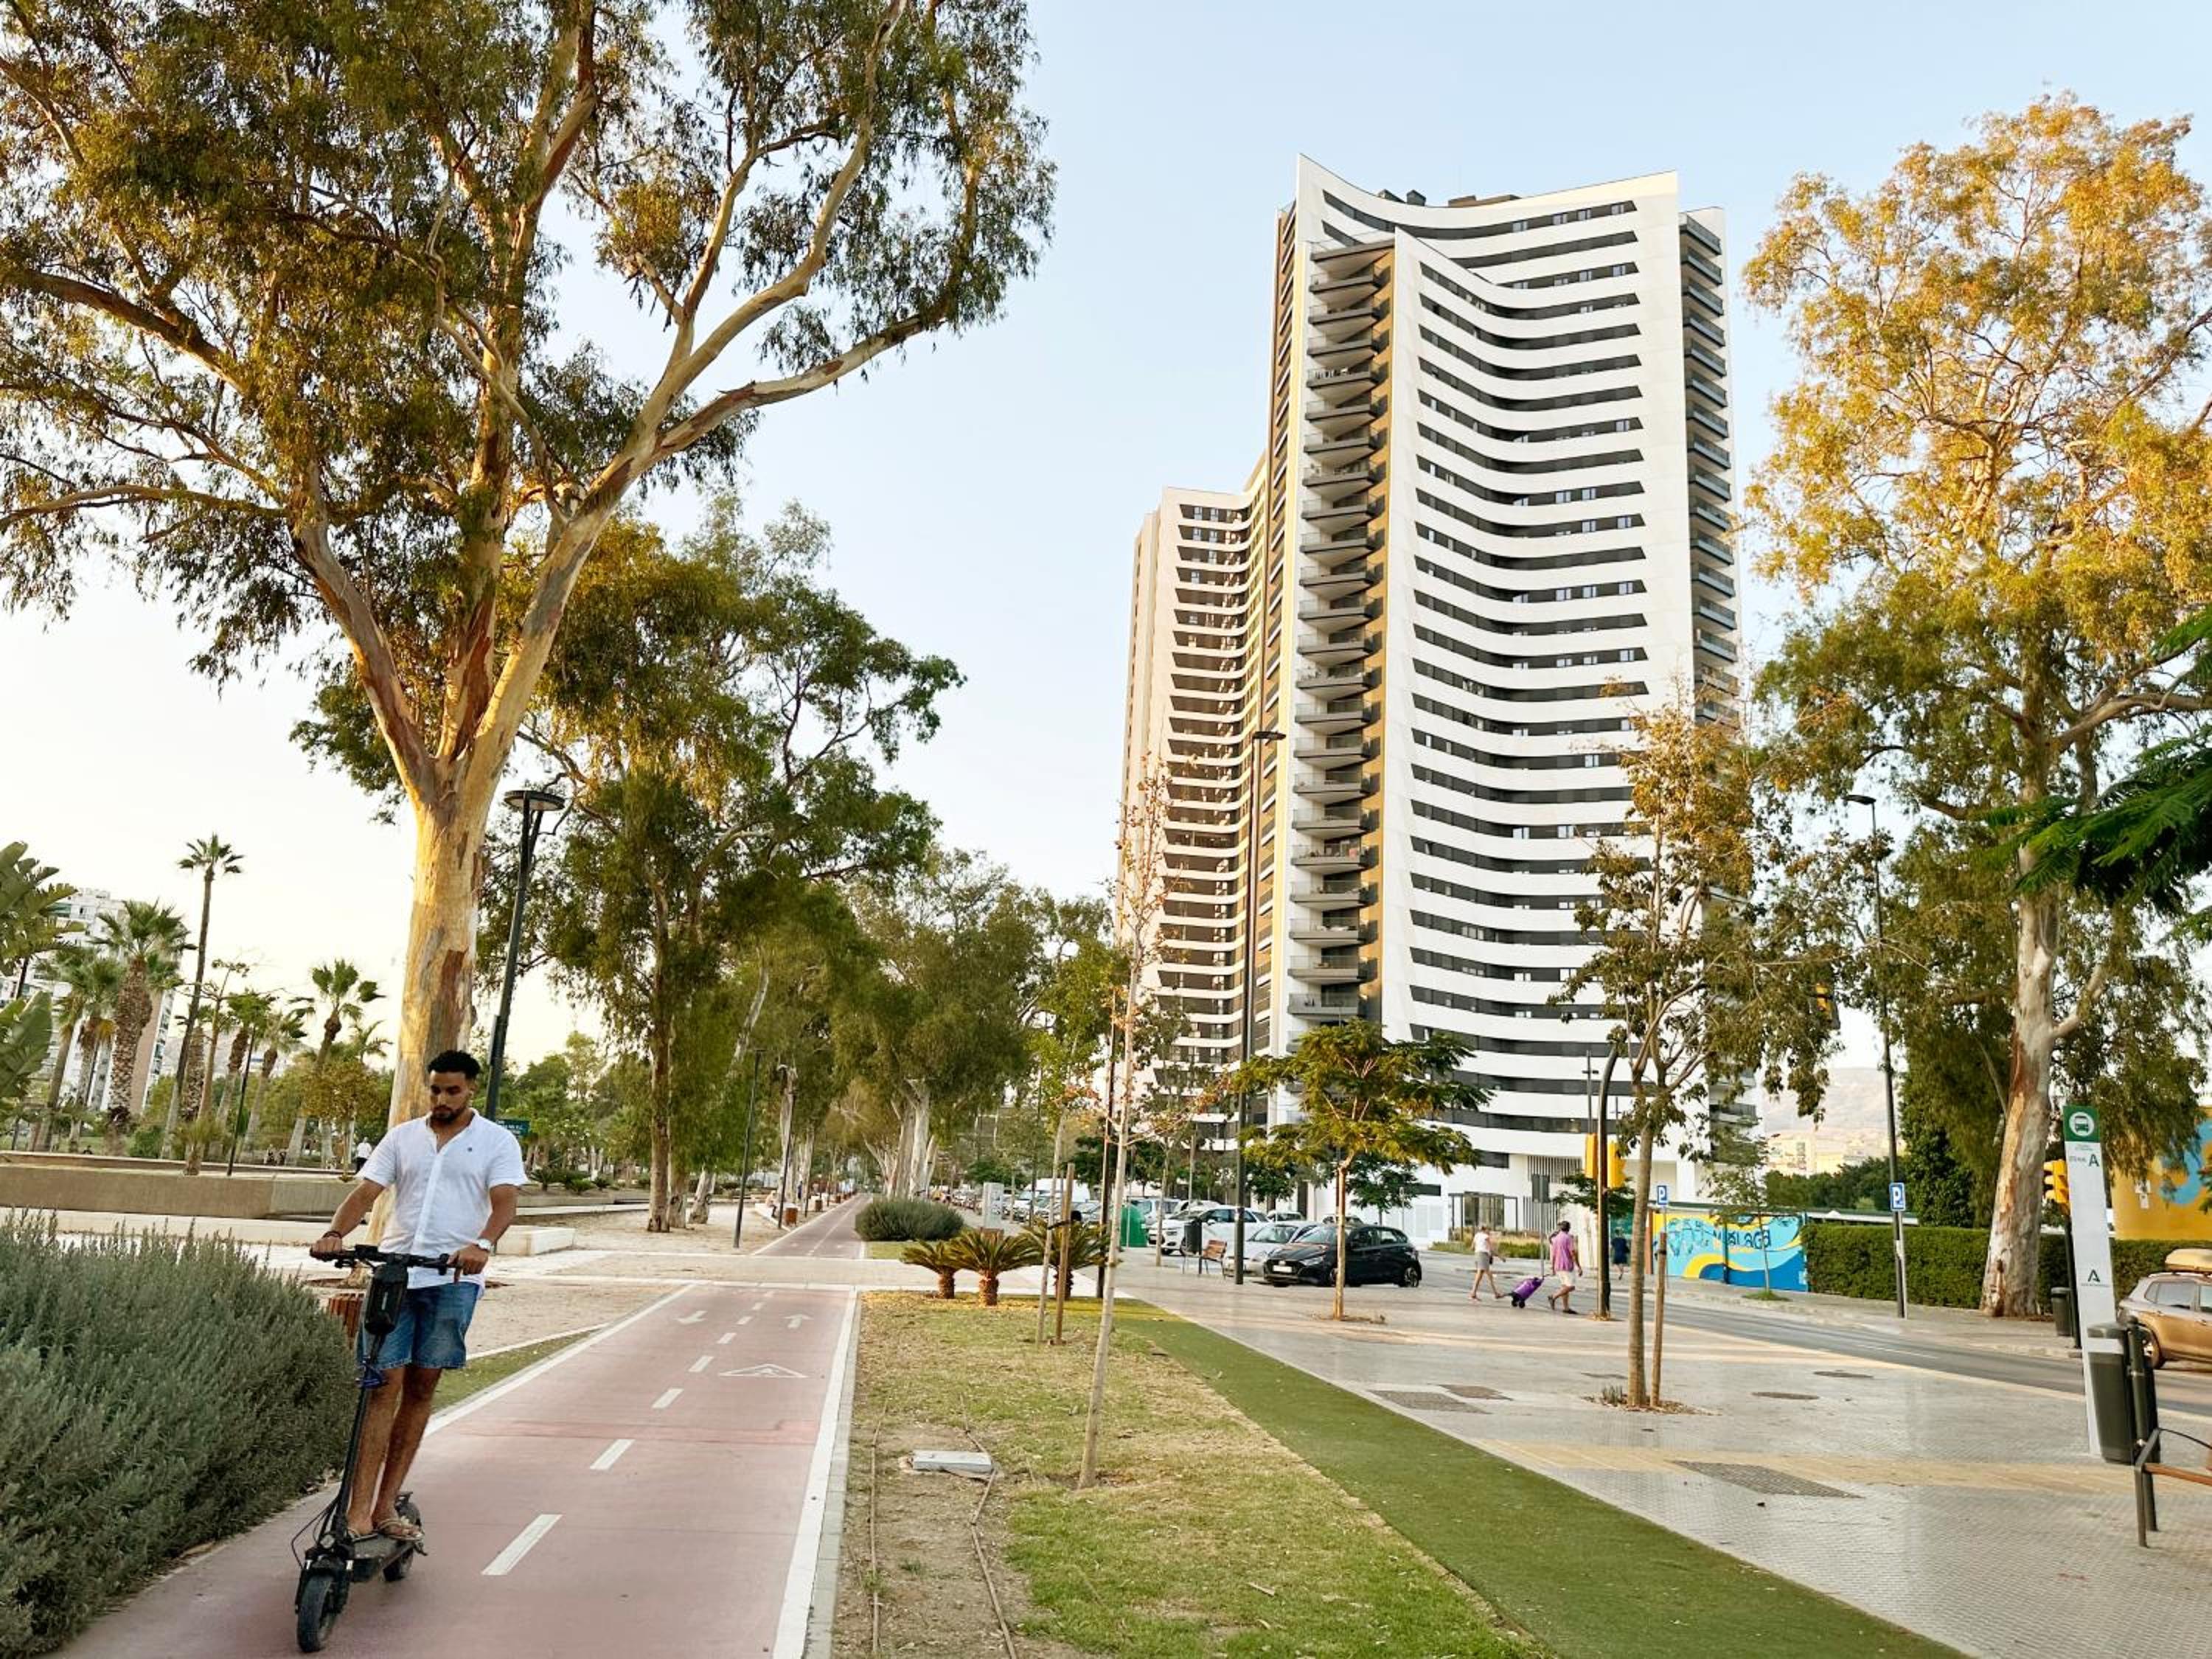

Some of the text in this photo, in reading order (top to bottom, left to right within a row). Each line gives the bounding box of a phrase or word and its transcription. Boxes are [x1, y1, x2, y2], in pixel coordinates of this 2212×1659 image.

[2088, 1154, 2099, 1166] A
[1658, 1186, 1666, 1203] P
[1892, 1186, 1902, 1208] P
